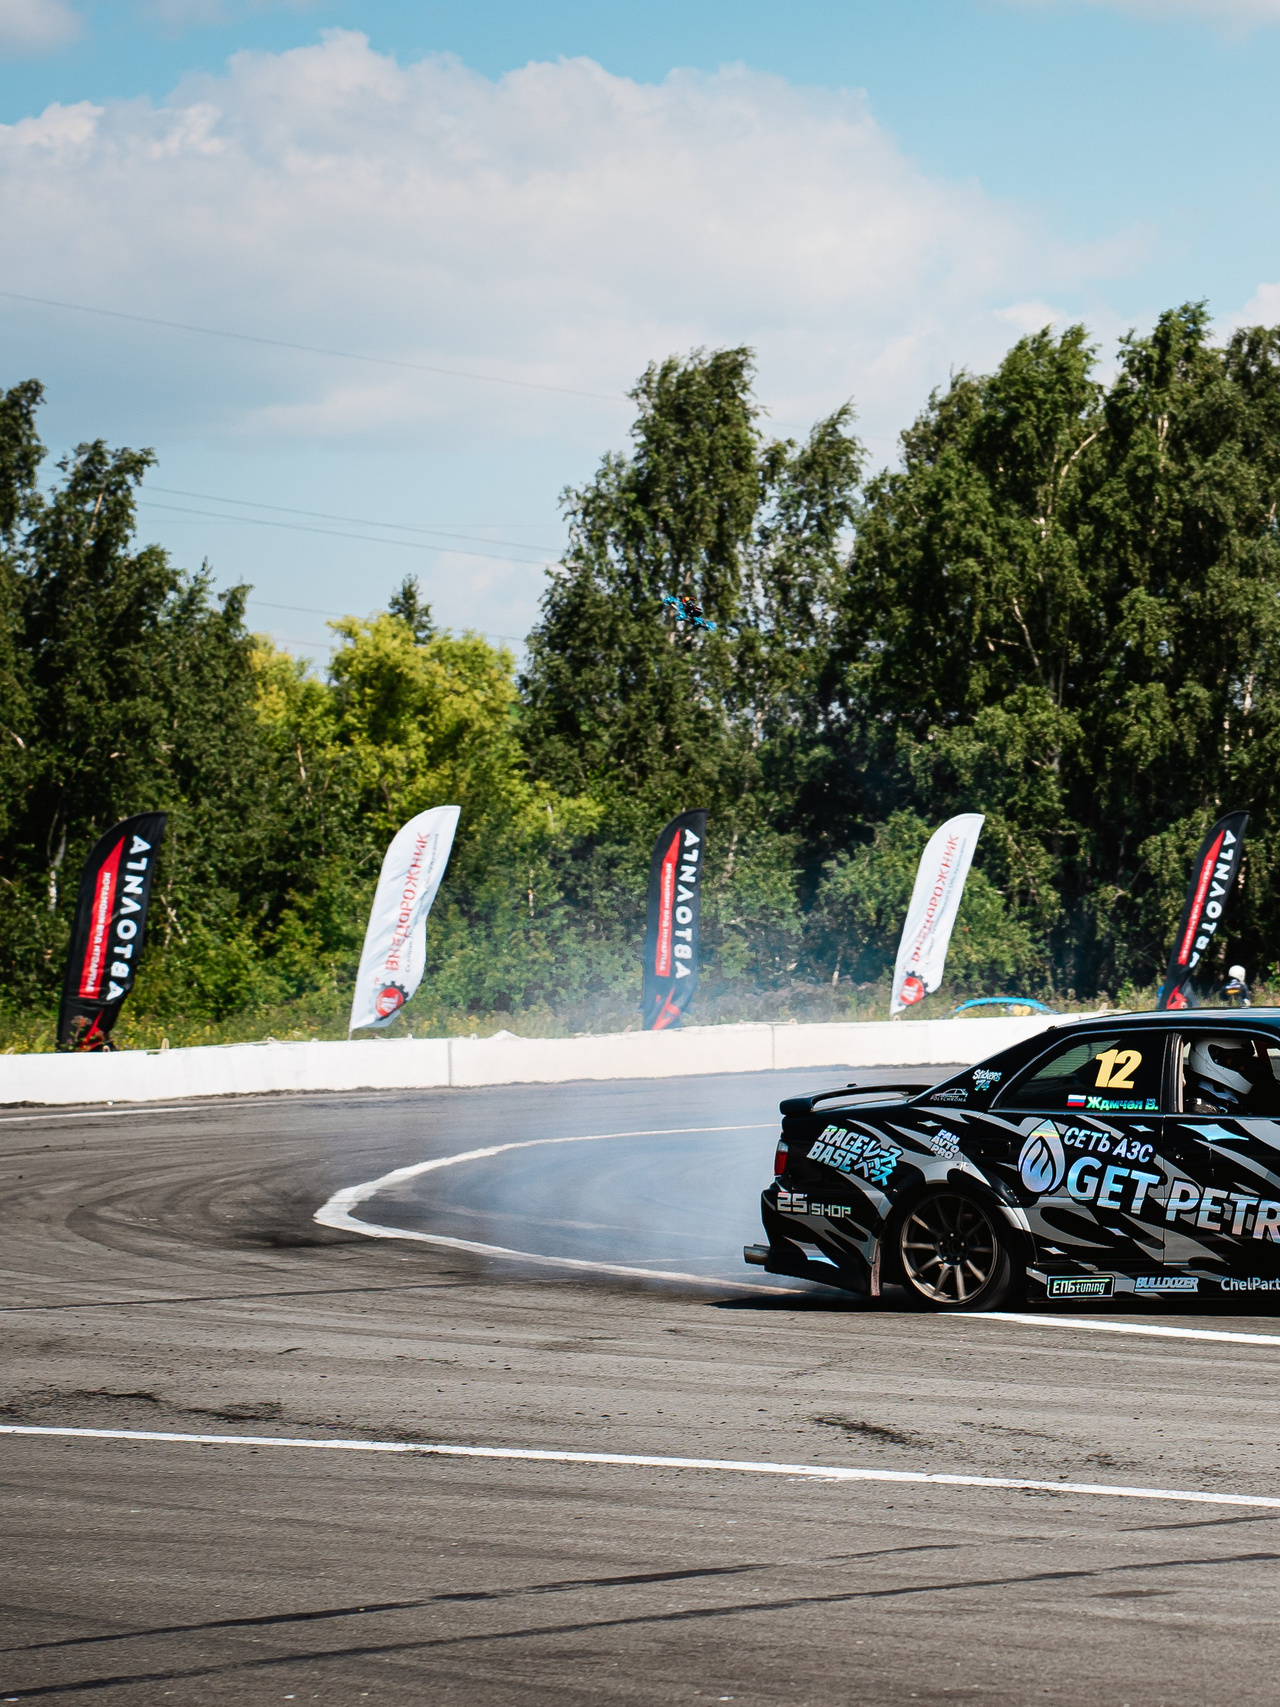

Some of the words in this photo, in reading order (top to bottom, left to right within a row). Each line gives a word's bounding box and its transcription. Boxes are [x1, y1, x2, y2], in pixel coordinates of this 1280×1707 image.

[385, 832, 431, 971] ВНЕДОРОЖНИК
[1095, 1049, 1142, 1089] 12
[974, 1080, 991, 1091] 74
[1144, 1098, 1159, 1110] В.
[817, 1124, 870, 1156] RACE
[930, 1135, 960, 1154] AVTO
[937, 1129, 960, 1145] FAN
[1063, 1126, 1110, 1151] СЕТЬ
[1112, 1137, 1154, 1164] АЗС
[806, 1141, 858, 1173] BASE
[930, 1143, 954, 1160] PRO
[1066, 1155, 1162, 1215] GET
[776, 1192, 808, 1213] 25
[811, 1202, 852, 1219] SHOP
[1135, 1277, 1199, 1292] BULLDOZER
